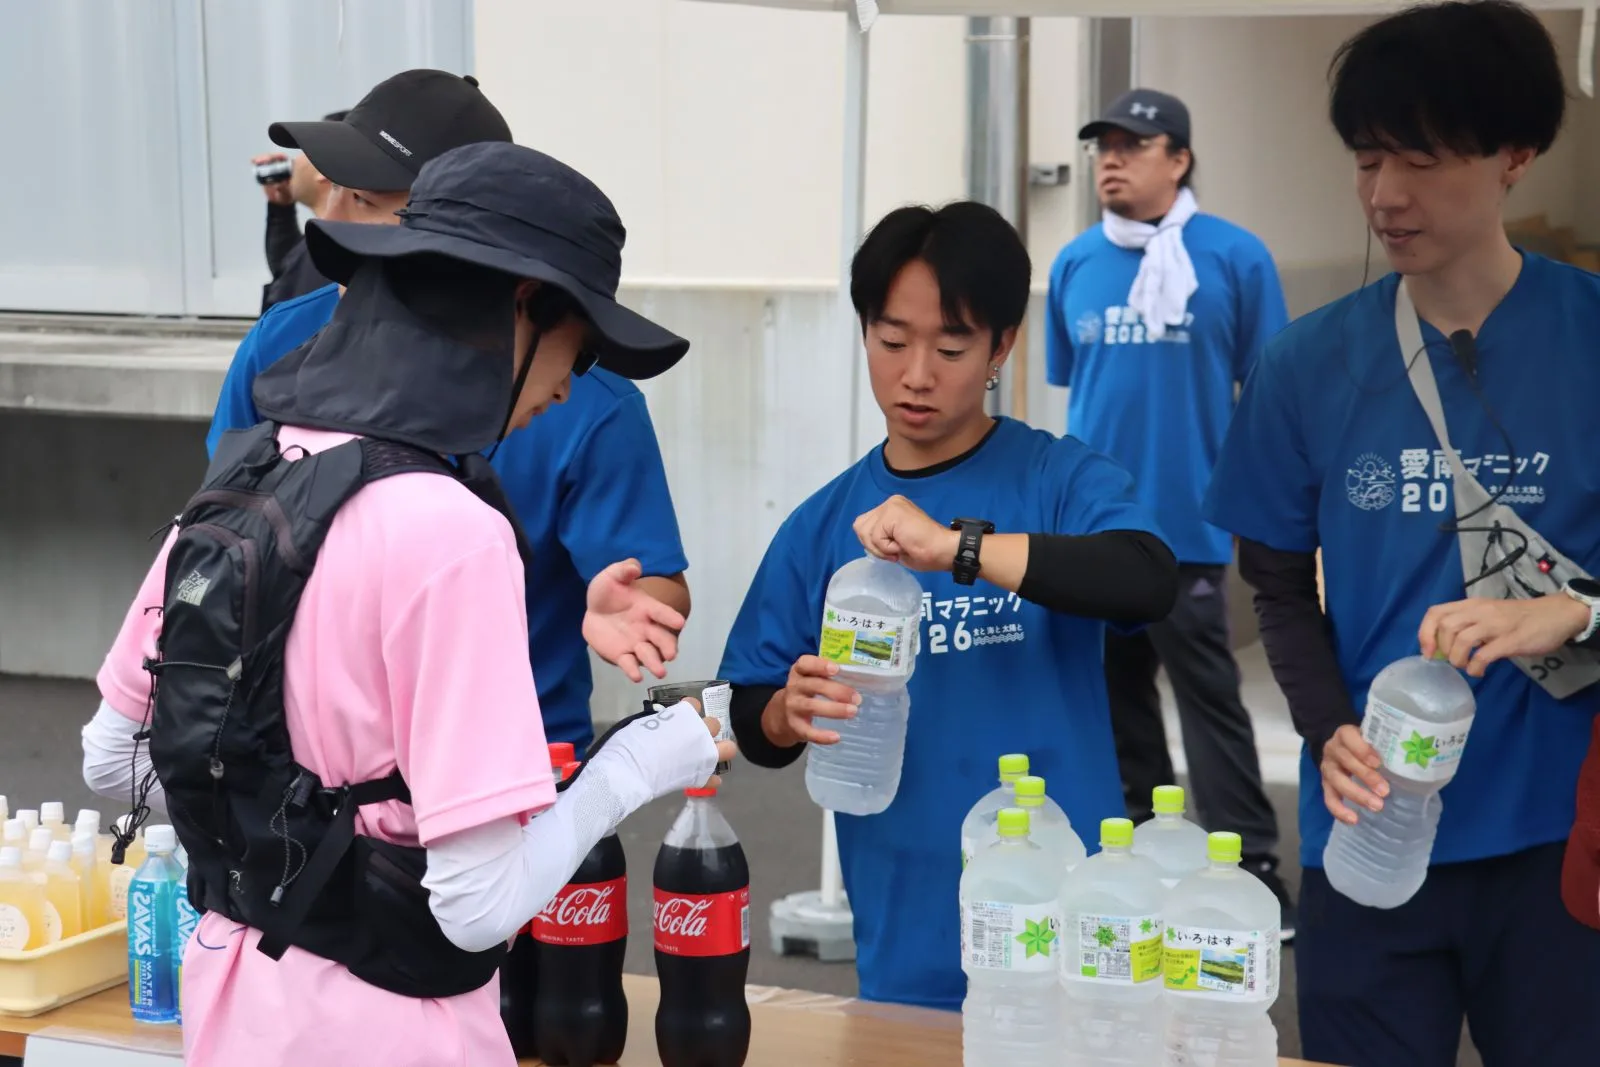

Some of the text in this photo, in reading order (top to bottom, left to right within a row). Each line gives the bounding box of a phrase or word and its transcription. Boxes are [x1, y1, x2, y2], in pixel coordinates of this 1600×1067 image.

[913, 620, 972, 656] 26
[132, 891, 151, 957] SAVAS
[145, 961, 153, 1007] WATER
